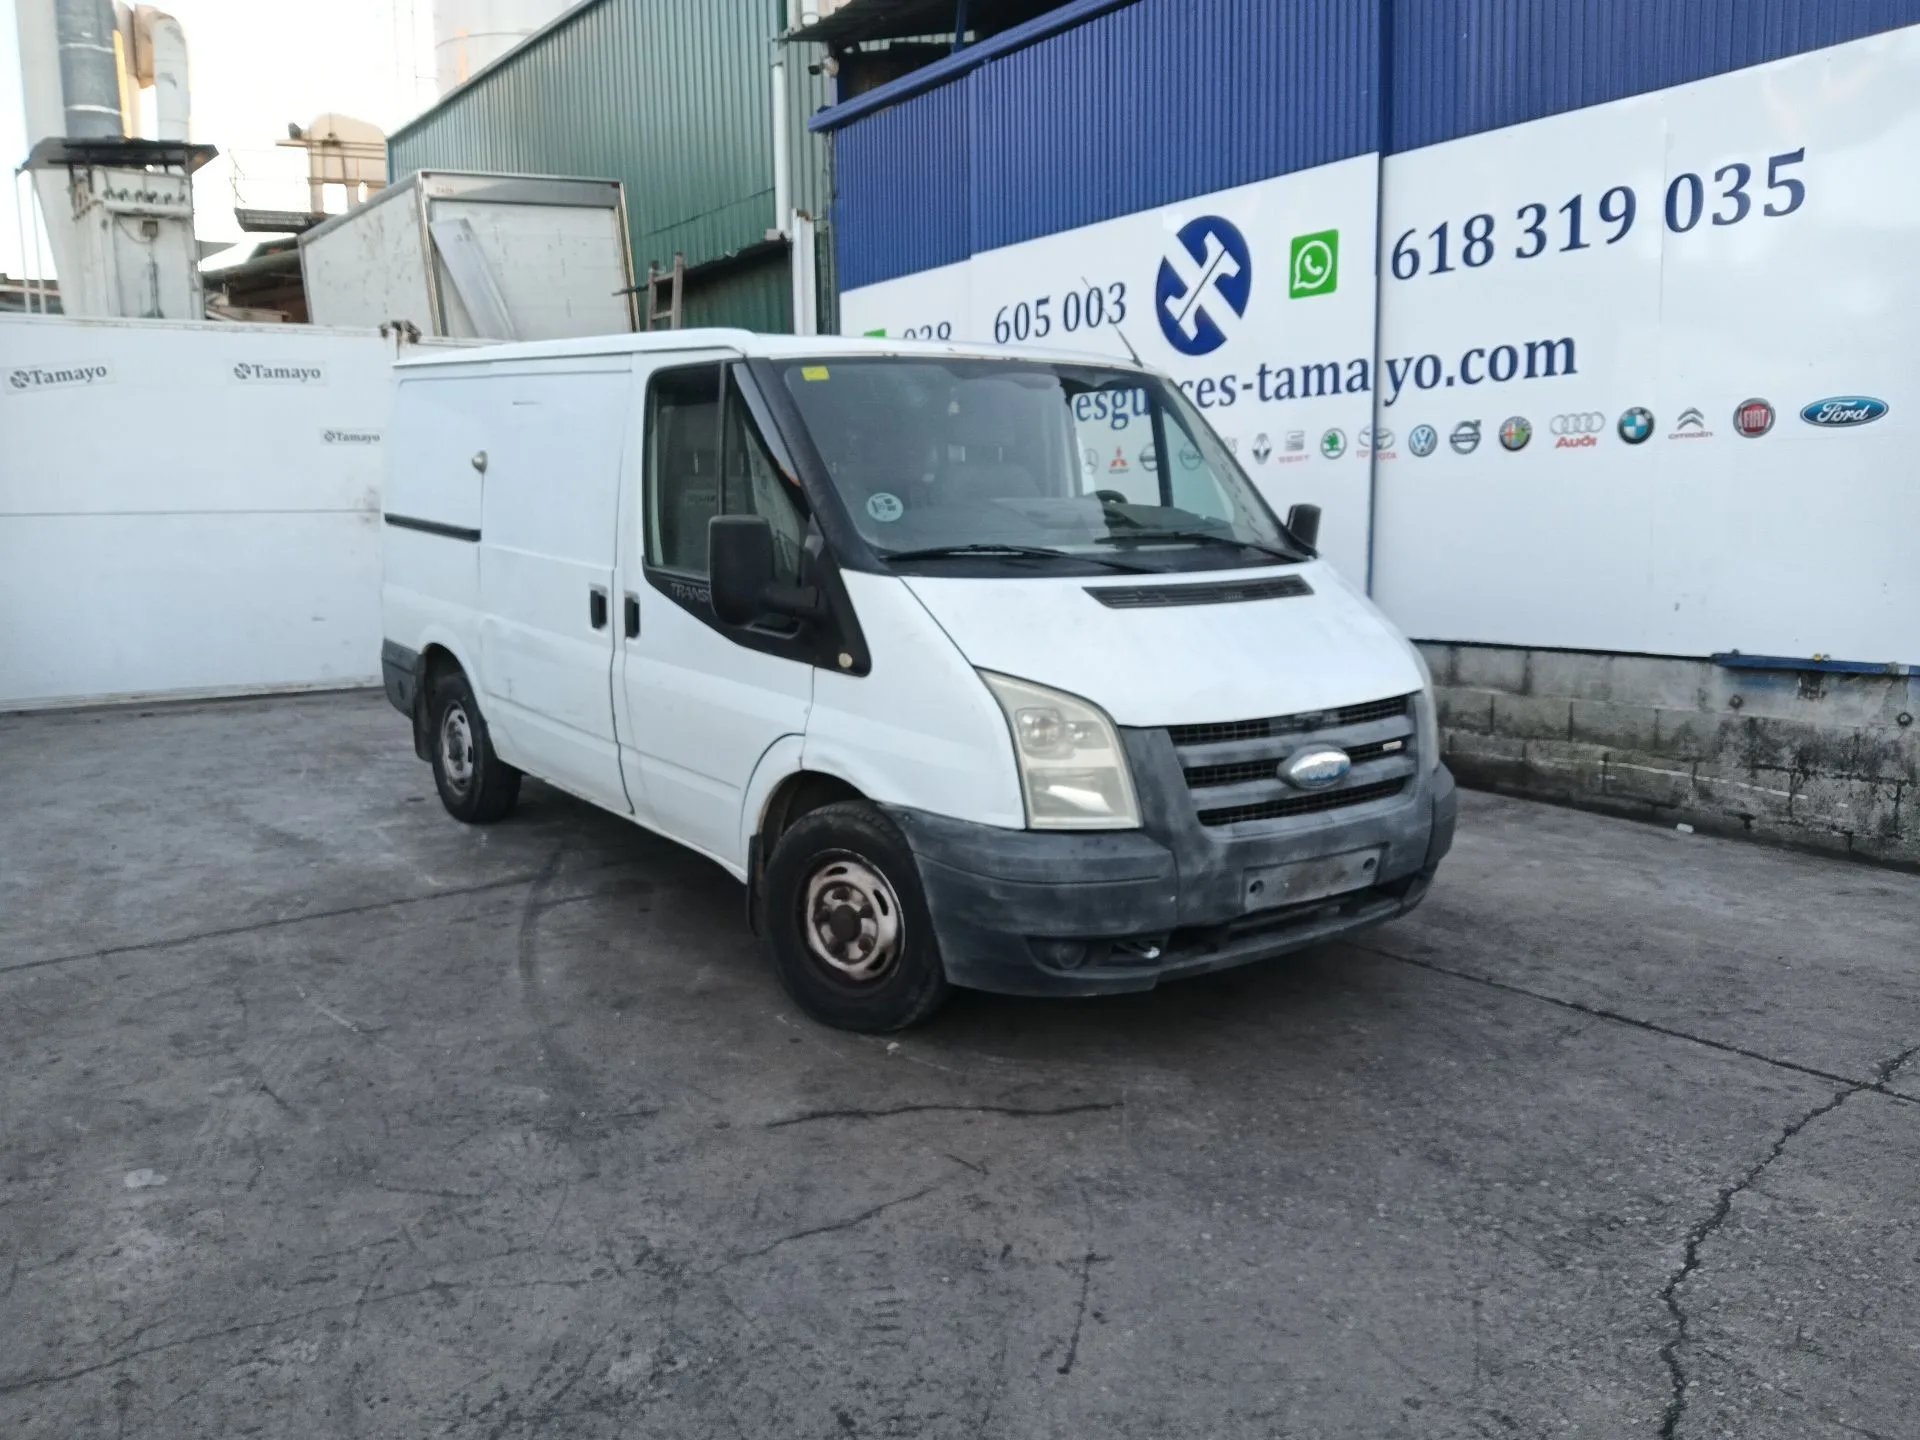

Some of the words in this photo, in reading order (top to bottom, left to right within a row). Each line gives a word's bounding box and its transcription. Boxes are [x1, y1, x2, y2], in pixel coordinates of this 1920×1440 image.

[1391, 213, 1495, 281] 618
[1515, 185, 1637, 259] 319
[1664, 147, 1806, 234] 035
[994, 296, 1051, 345] 605
[1062, 282, 1126, 333] 003
[29, 364, 107, 386] Tamayo
[252, 365, 321, 380] Tamayo
[1743, 409, 1768, 428] FIAT
[1816, 401, 1869, 423] Ford
[336, 431, 381, 443] Tamayo
[1556, 436, 1597, 449] Audi
[670, 583, 711, 603] TRANS
